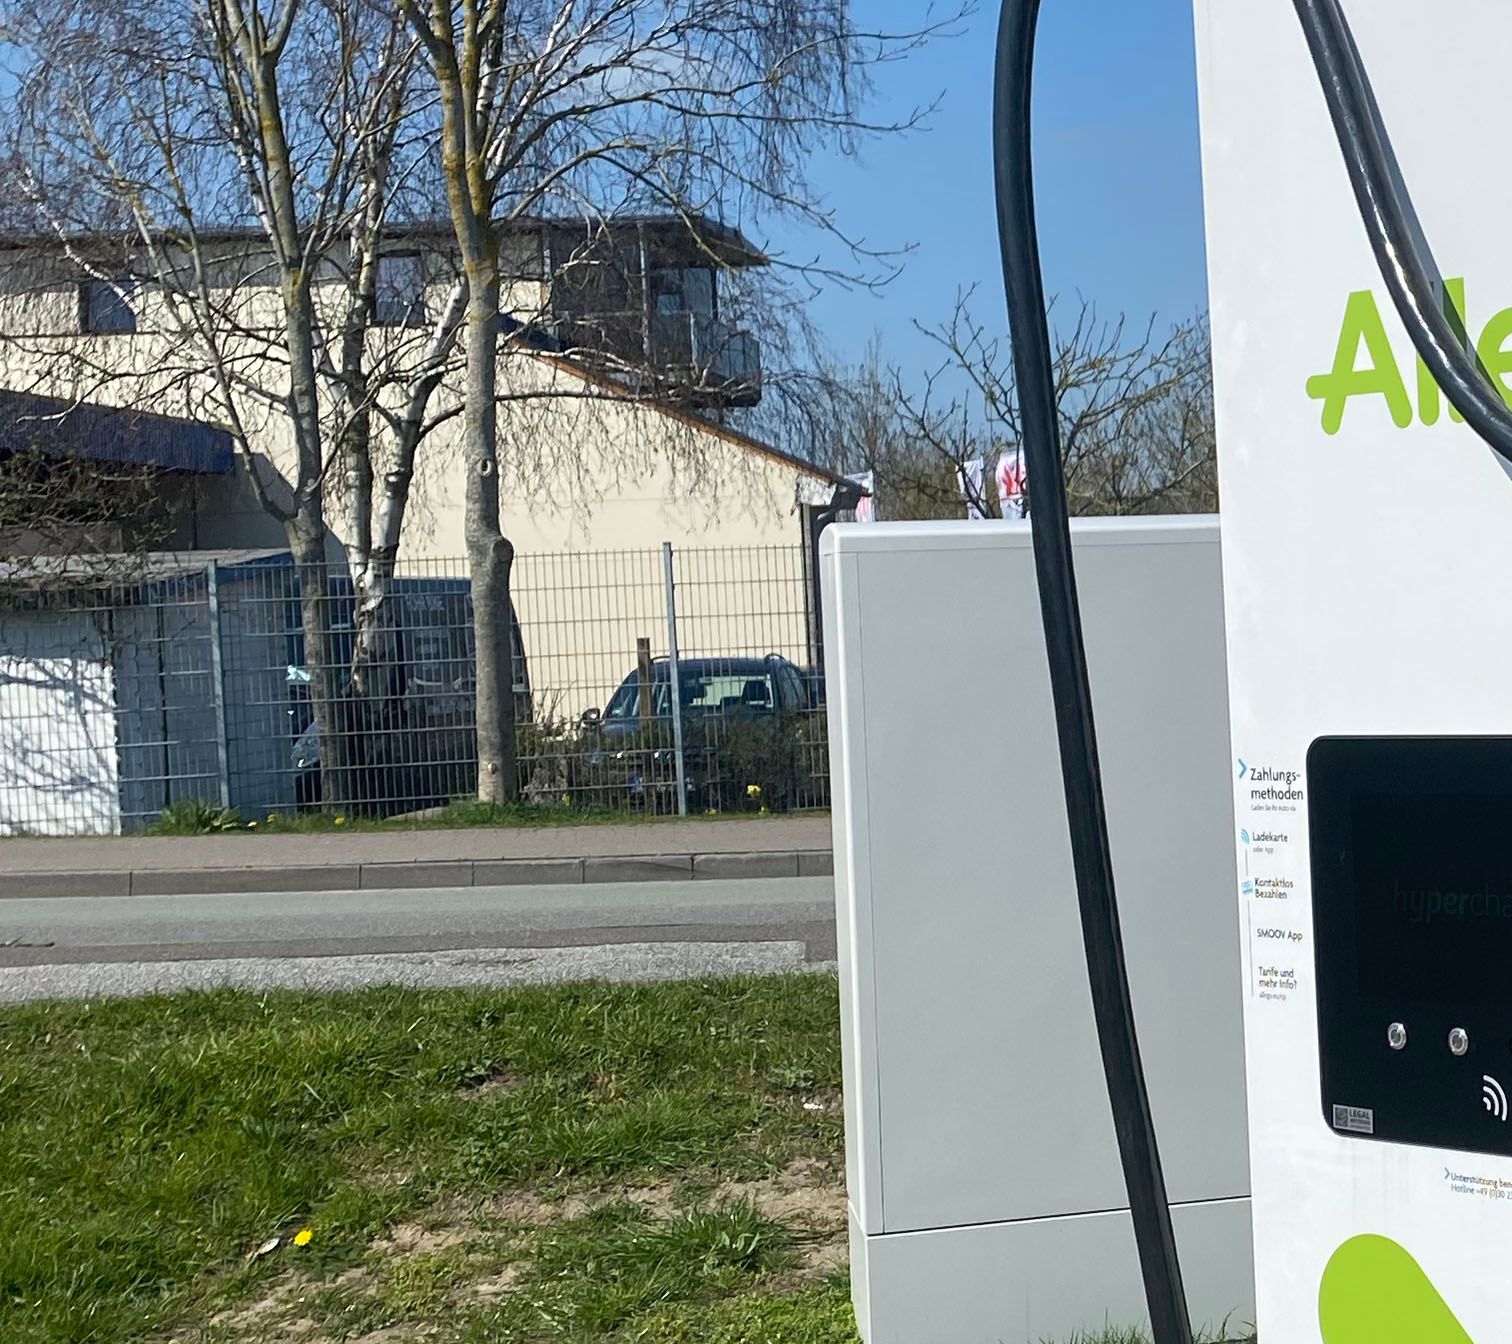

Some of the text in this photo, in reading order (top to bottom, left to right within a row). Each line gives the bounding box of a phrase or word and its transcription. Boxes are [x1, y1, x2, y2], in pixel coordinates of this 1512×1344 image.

[1250, 766, 1301, 786] Zahlungs-
[1250, 785, 1304, 801] methoden
[1252, 831, 1288, 843] Ladekarte
[1254, 876, 1294, 889] Kontaktlos
[1254, 888, 1288, 900] Bezahlen
[1256, 928, 1303, 943] SMOOV App
